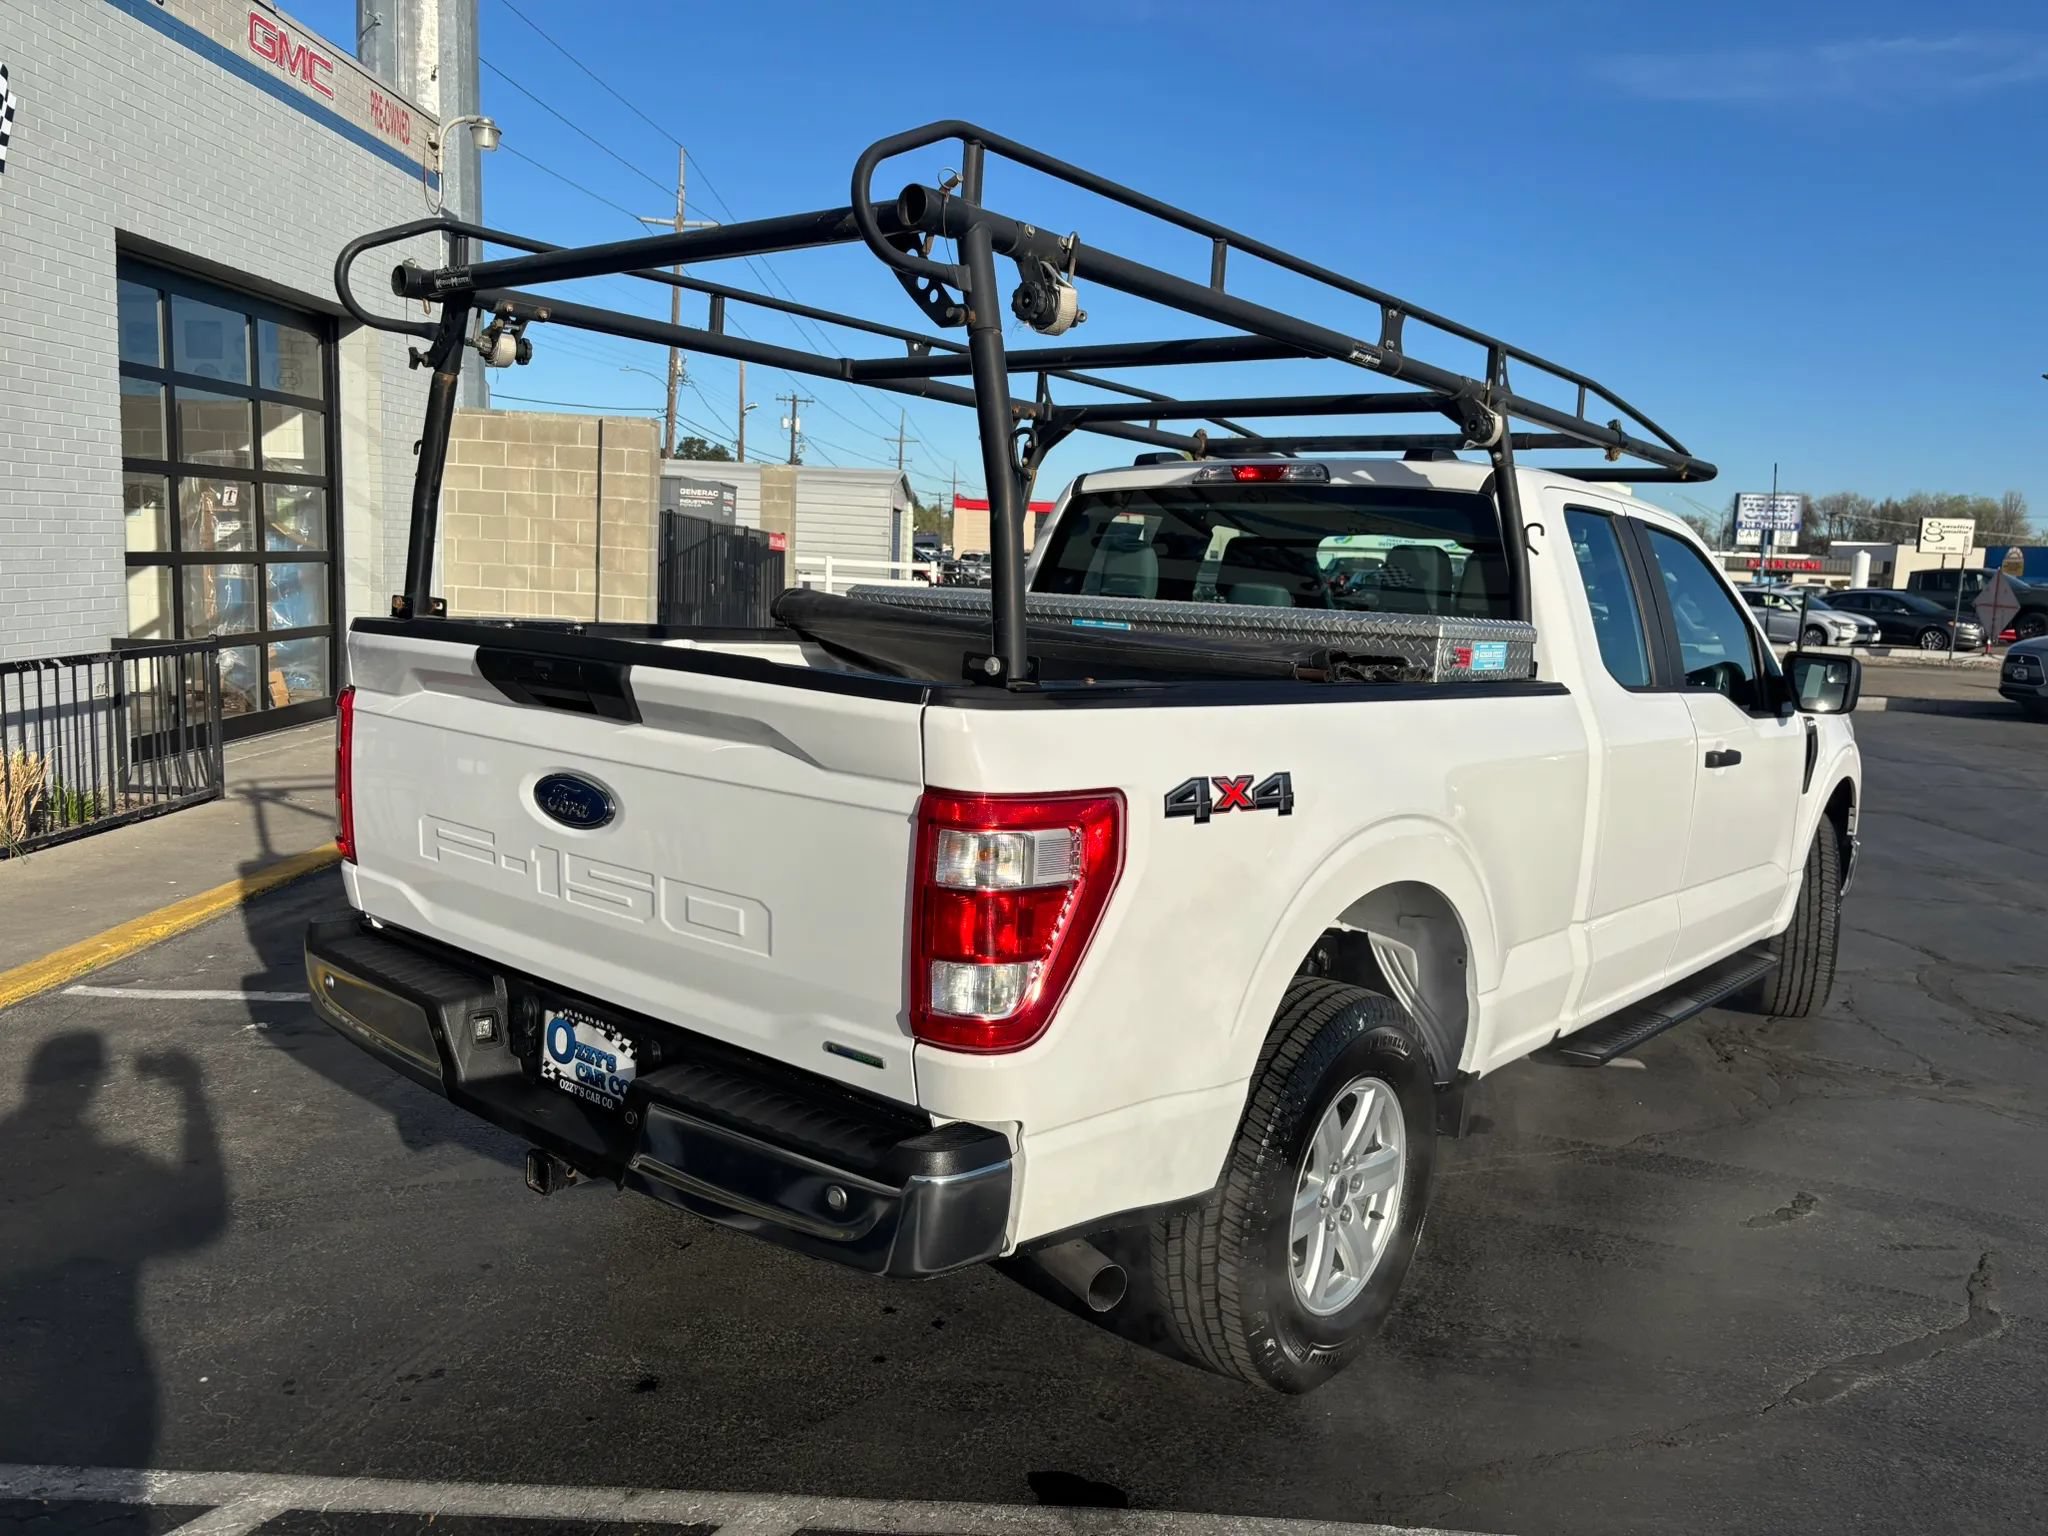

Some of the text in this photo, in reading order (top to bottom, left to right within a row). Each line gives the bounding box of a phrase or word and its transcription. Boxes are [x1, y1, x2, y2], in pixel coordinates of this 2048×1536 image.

[248, 10, 334, 100] GMC
[680, 488, 719, 497] GENERAC
[546, 784, 592, 818] Ford
[418, 814, 773, 957] F-150
[547, 1016, 617, 1074] OZZY'S
[575, 1062, 606, 1090] CAR
[559, 1078, 615, 1110] OZZY'S CAR CO.
